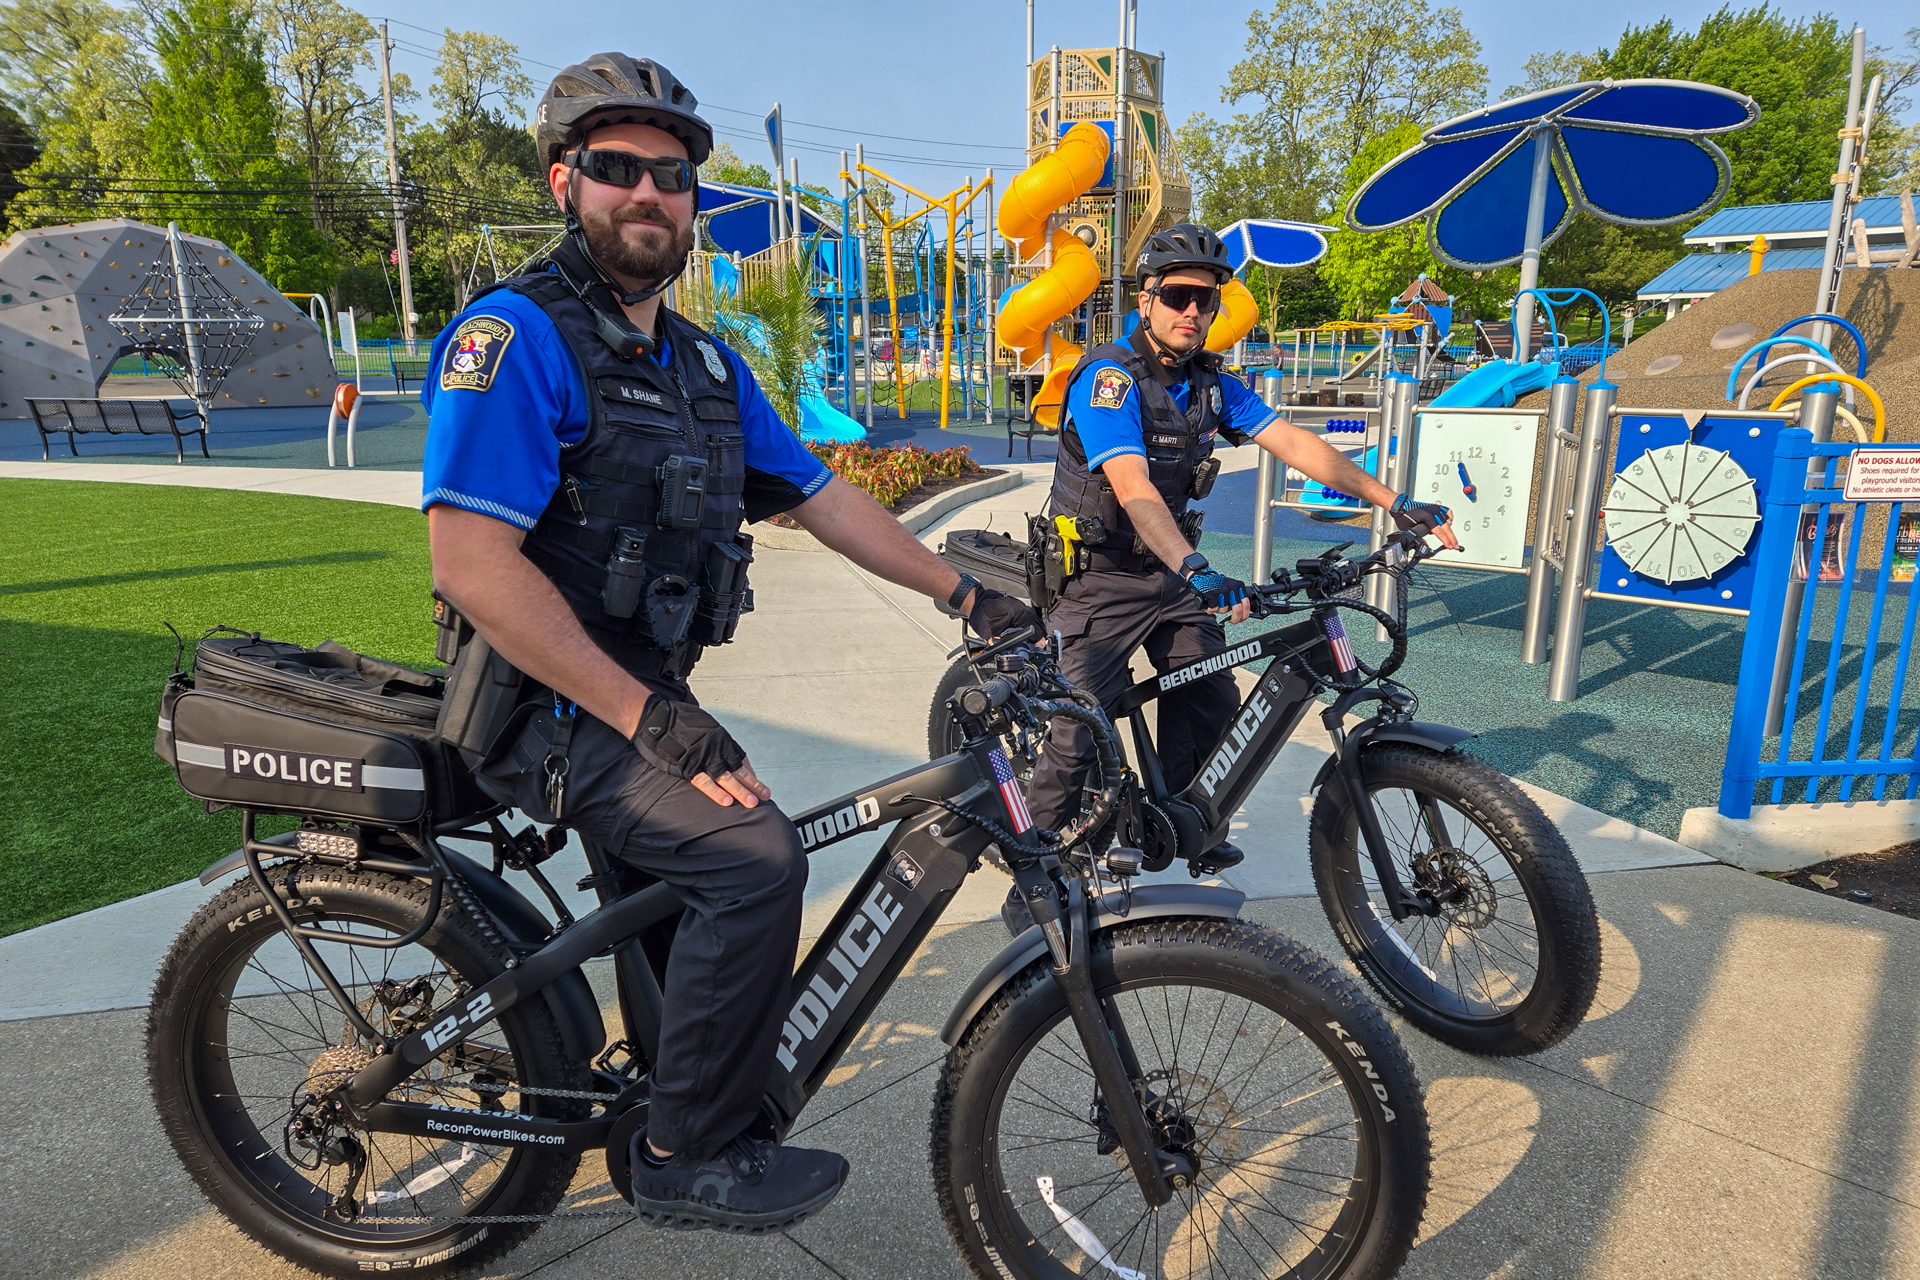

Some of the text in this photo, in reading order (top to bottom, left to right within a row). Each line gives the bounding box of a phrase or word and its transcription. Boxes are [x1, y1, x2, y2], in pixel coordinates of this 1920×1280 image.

[450, 375, 476, 383] POLICE
[621, 386, 662, 405] M. SHANE
[1159, 435, 1177, 444] MARTI
[1449, 451, 1462, 462] 11
[1468, 447, 1482, 458] 12
[1490, 453, 1496, 464] 1
[1663, 449, 1674, 462] 4
[1696, 450, 1709, 463] 5
[1435, 464, 1449, 475] 10
[1501, 467, 1509, 479] 2
[1632, 464, 1644, 476] 3
[1724, 467, 1738, 480] 6
[1882, 466, 1909, 475] required
[1861, 477, 1898, 485] playground
[1431, 482, 1439, 493] 9
[1504, 486, 1512, 497] 3
[1612, 489, 1626, 500] 2
[1738, 496, 1753, 505] 7
[1497, 505, 1505, 516] 4
[1463, 520, 1471, 532] 6
[1482, 517, 1490, 528] 5
[1733, 527, 1747, 538] 8
[1619, 541, 1636, 560] 12
[1713, 551, 1725, 564] 9
[1646, 560, 1661, 576] 11
[1677, 564, 1696, 577] 10
[1159, 640, 1262, 692] BEACHWOOD
[1199, 690, 1272, 798] POLICE
[232, 748, 353, 787] POLICE
[1459, 797, 1522, 864] KENDA
[775, 881, 904, 1073] POLICE
[421, 991, 495, 1052] 12-2
[1325, 1020, 1397, 1123] KENDA
[428, 1103, 534, 1121] RECON
[427, 1119, 565, 1145] ReconPowerBikes.com
[413, 1233, 480, 1269] JUGGERNAUT
